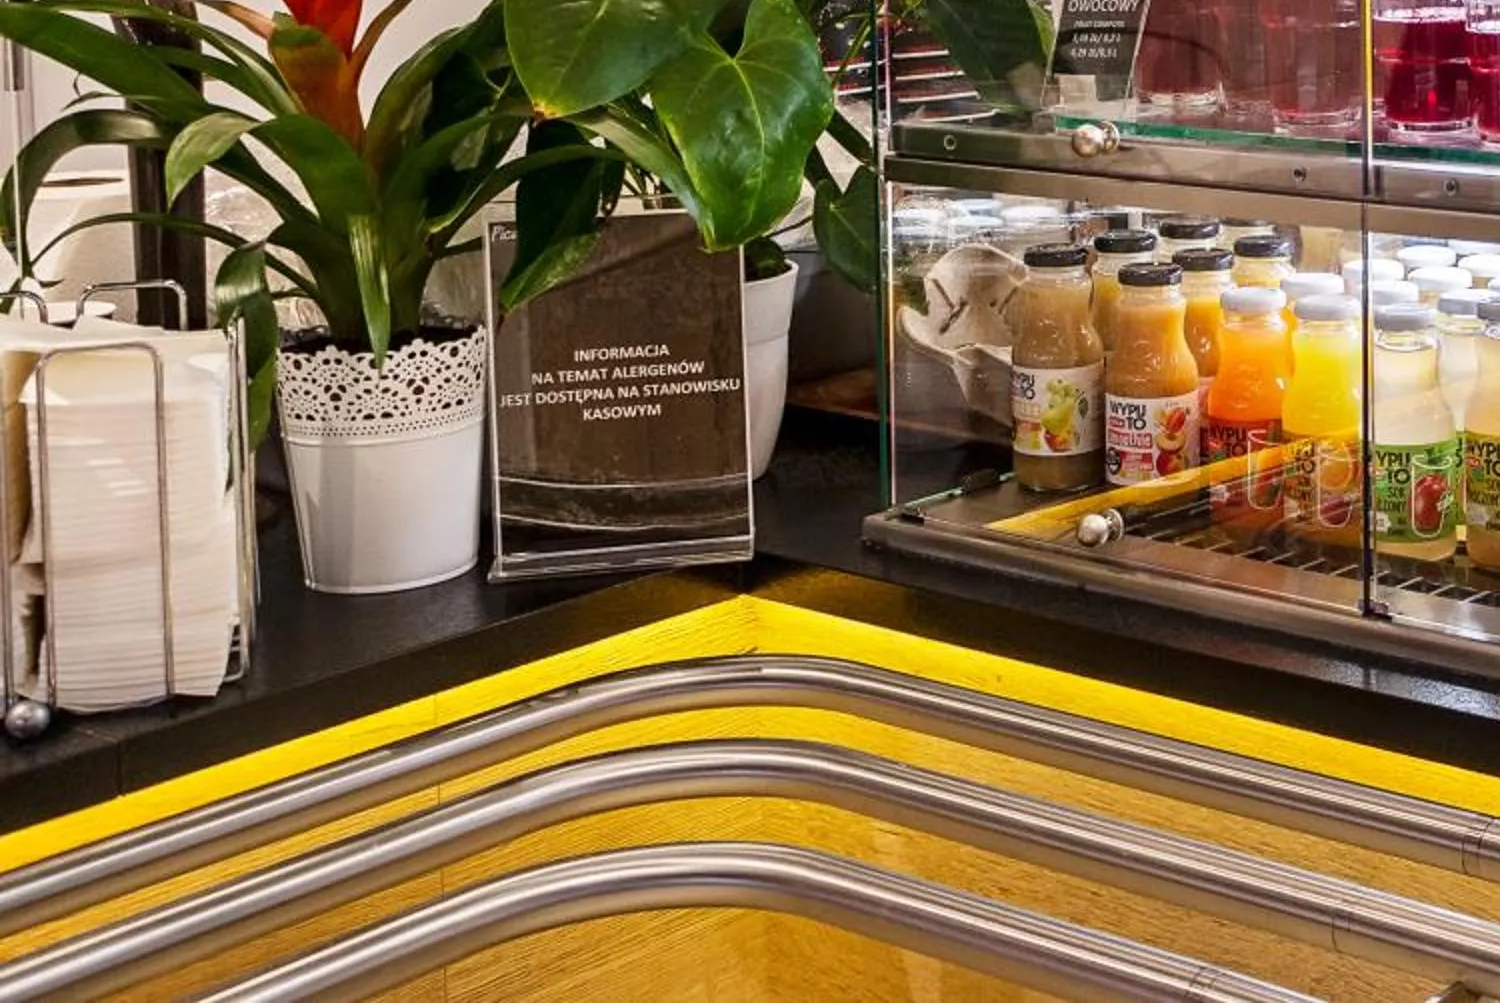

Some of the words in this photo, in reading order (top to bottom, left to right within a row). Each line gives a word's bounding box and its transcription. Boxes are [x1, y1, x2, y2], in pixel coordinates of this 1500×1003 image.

[574, 344, 670, 362] INFORMACJA
[531, 372, 554, 385] NA
[559, 368, 608, 384] TEMAT
[612, 360, 705, 379] ALERGENÓW
[499, 393, 532, 408] JEST
[535, 388, 614, 405] DOSTĘPNA
[617, 386, 640, 399] NA
[642, 378, 740, 397] STANOWISKU
[583, 404, 661, 421] KASOWYM
[1110, 401, 1147, 418] WYPU
[1126, 417, 1147, 431] TO
[1376, 450, 1410, 467] YPU
[1384, 468, 1411, 485] TO
